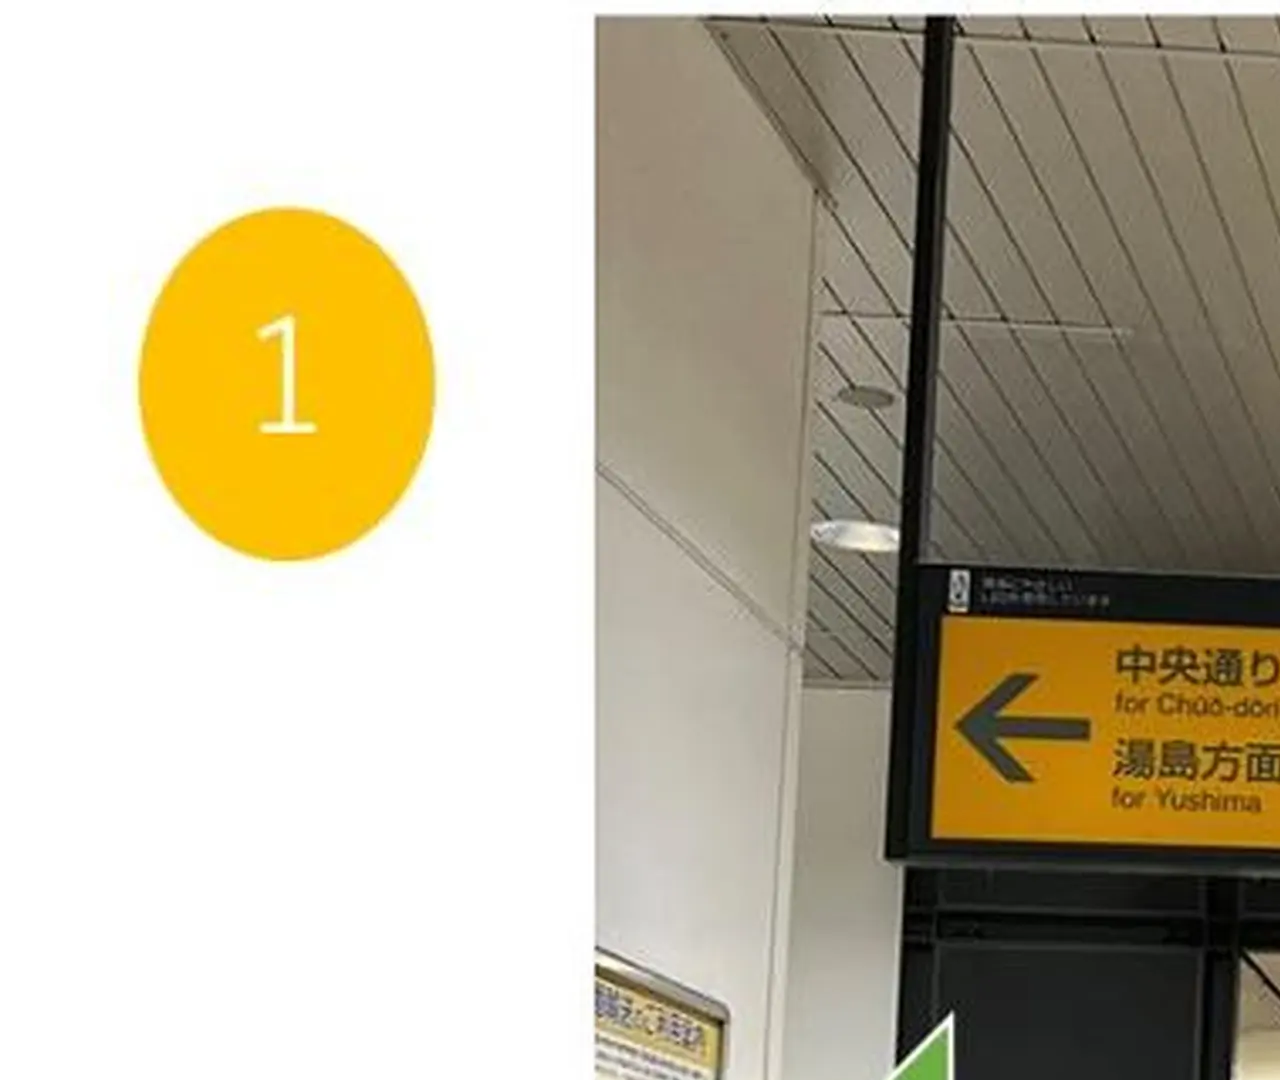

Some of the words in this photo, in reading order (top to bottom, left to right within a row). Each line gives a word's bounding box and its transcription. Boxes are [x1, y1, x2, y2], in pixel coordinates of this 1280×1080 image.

[1114, 694, 1151, 714] for
[1111, 788, 1147, 808] for
[1153, 790, 1262, 814] Yushima
